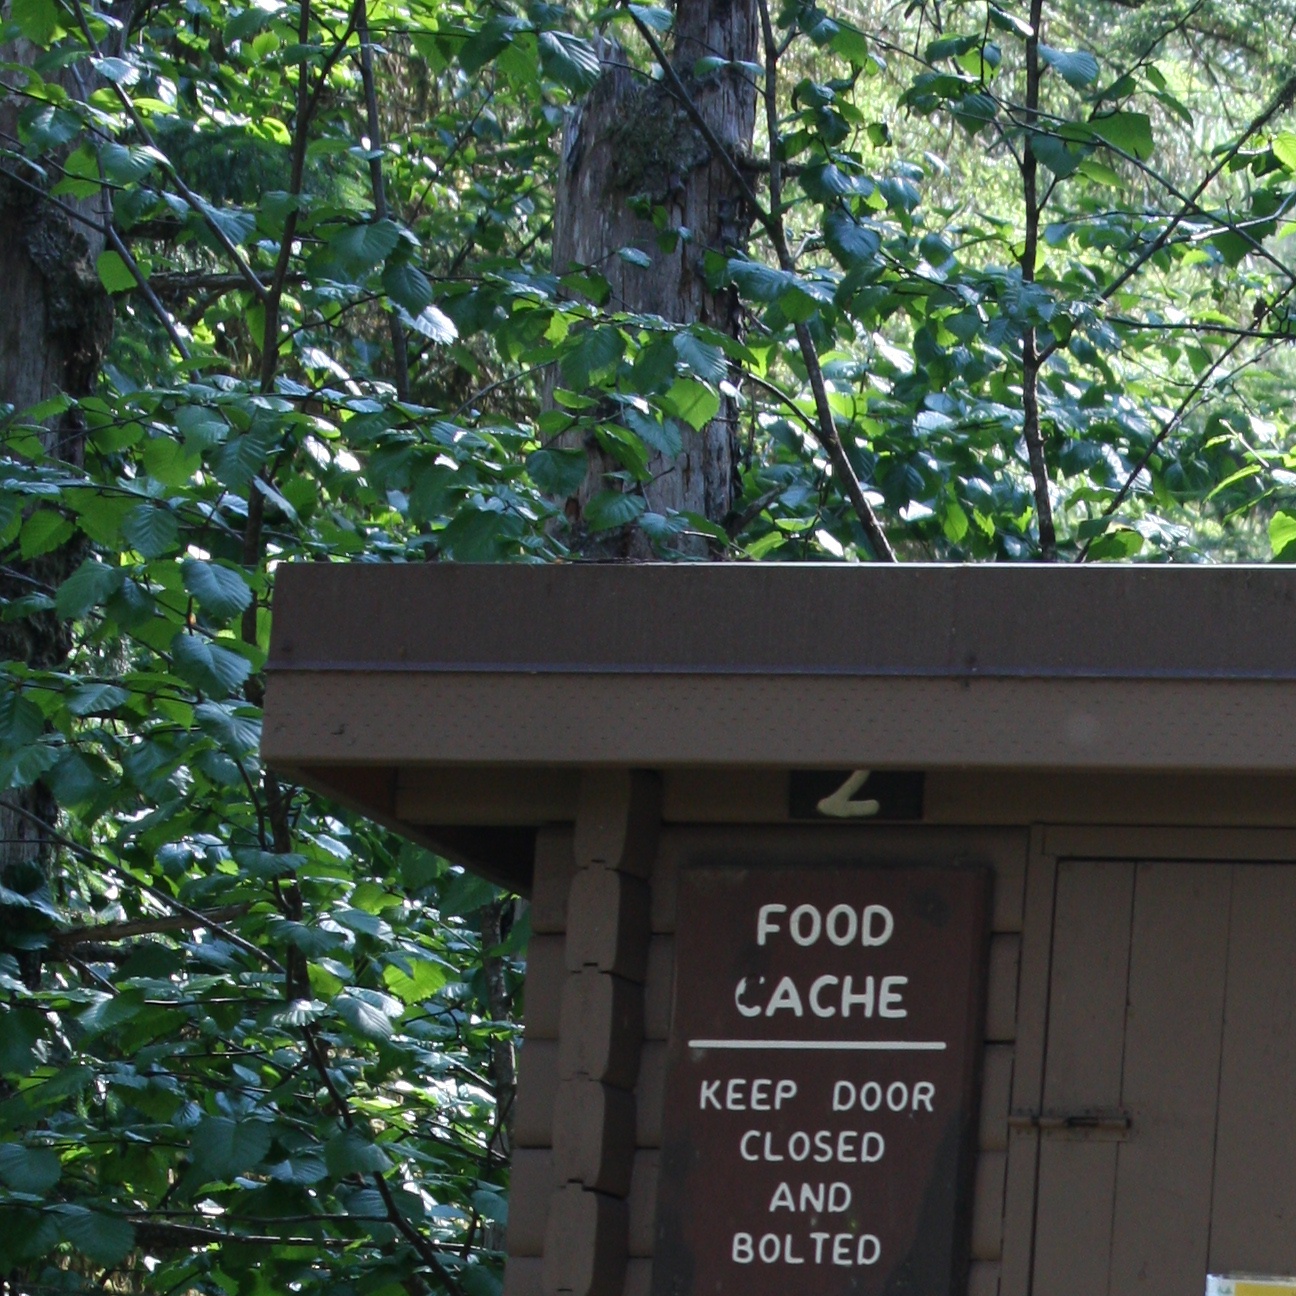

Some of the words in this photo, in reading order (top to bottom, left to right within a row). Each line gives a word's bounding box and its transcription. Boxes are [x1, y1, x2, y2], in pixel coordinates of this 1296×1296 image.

[757, 903, 895, 948] FOOD
[735, 974, 910, 1020] CACHE
[700, 1079, 798, 1112] KEEP
[832, 1081, 936, 1112] DOOR
[740, 1130, 886, 1164] CLOSED
[769, 1182, 853, 1214] AND
[732, 1233, 882, 1267] BOLTED
